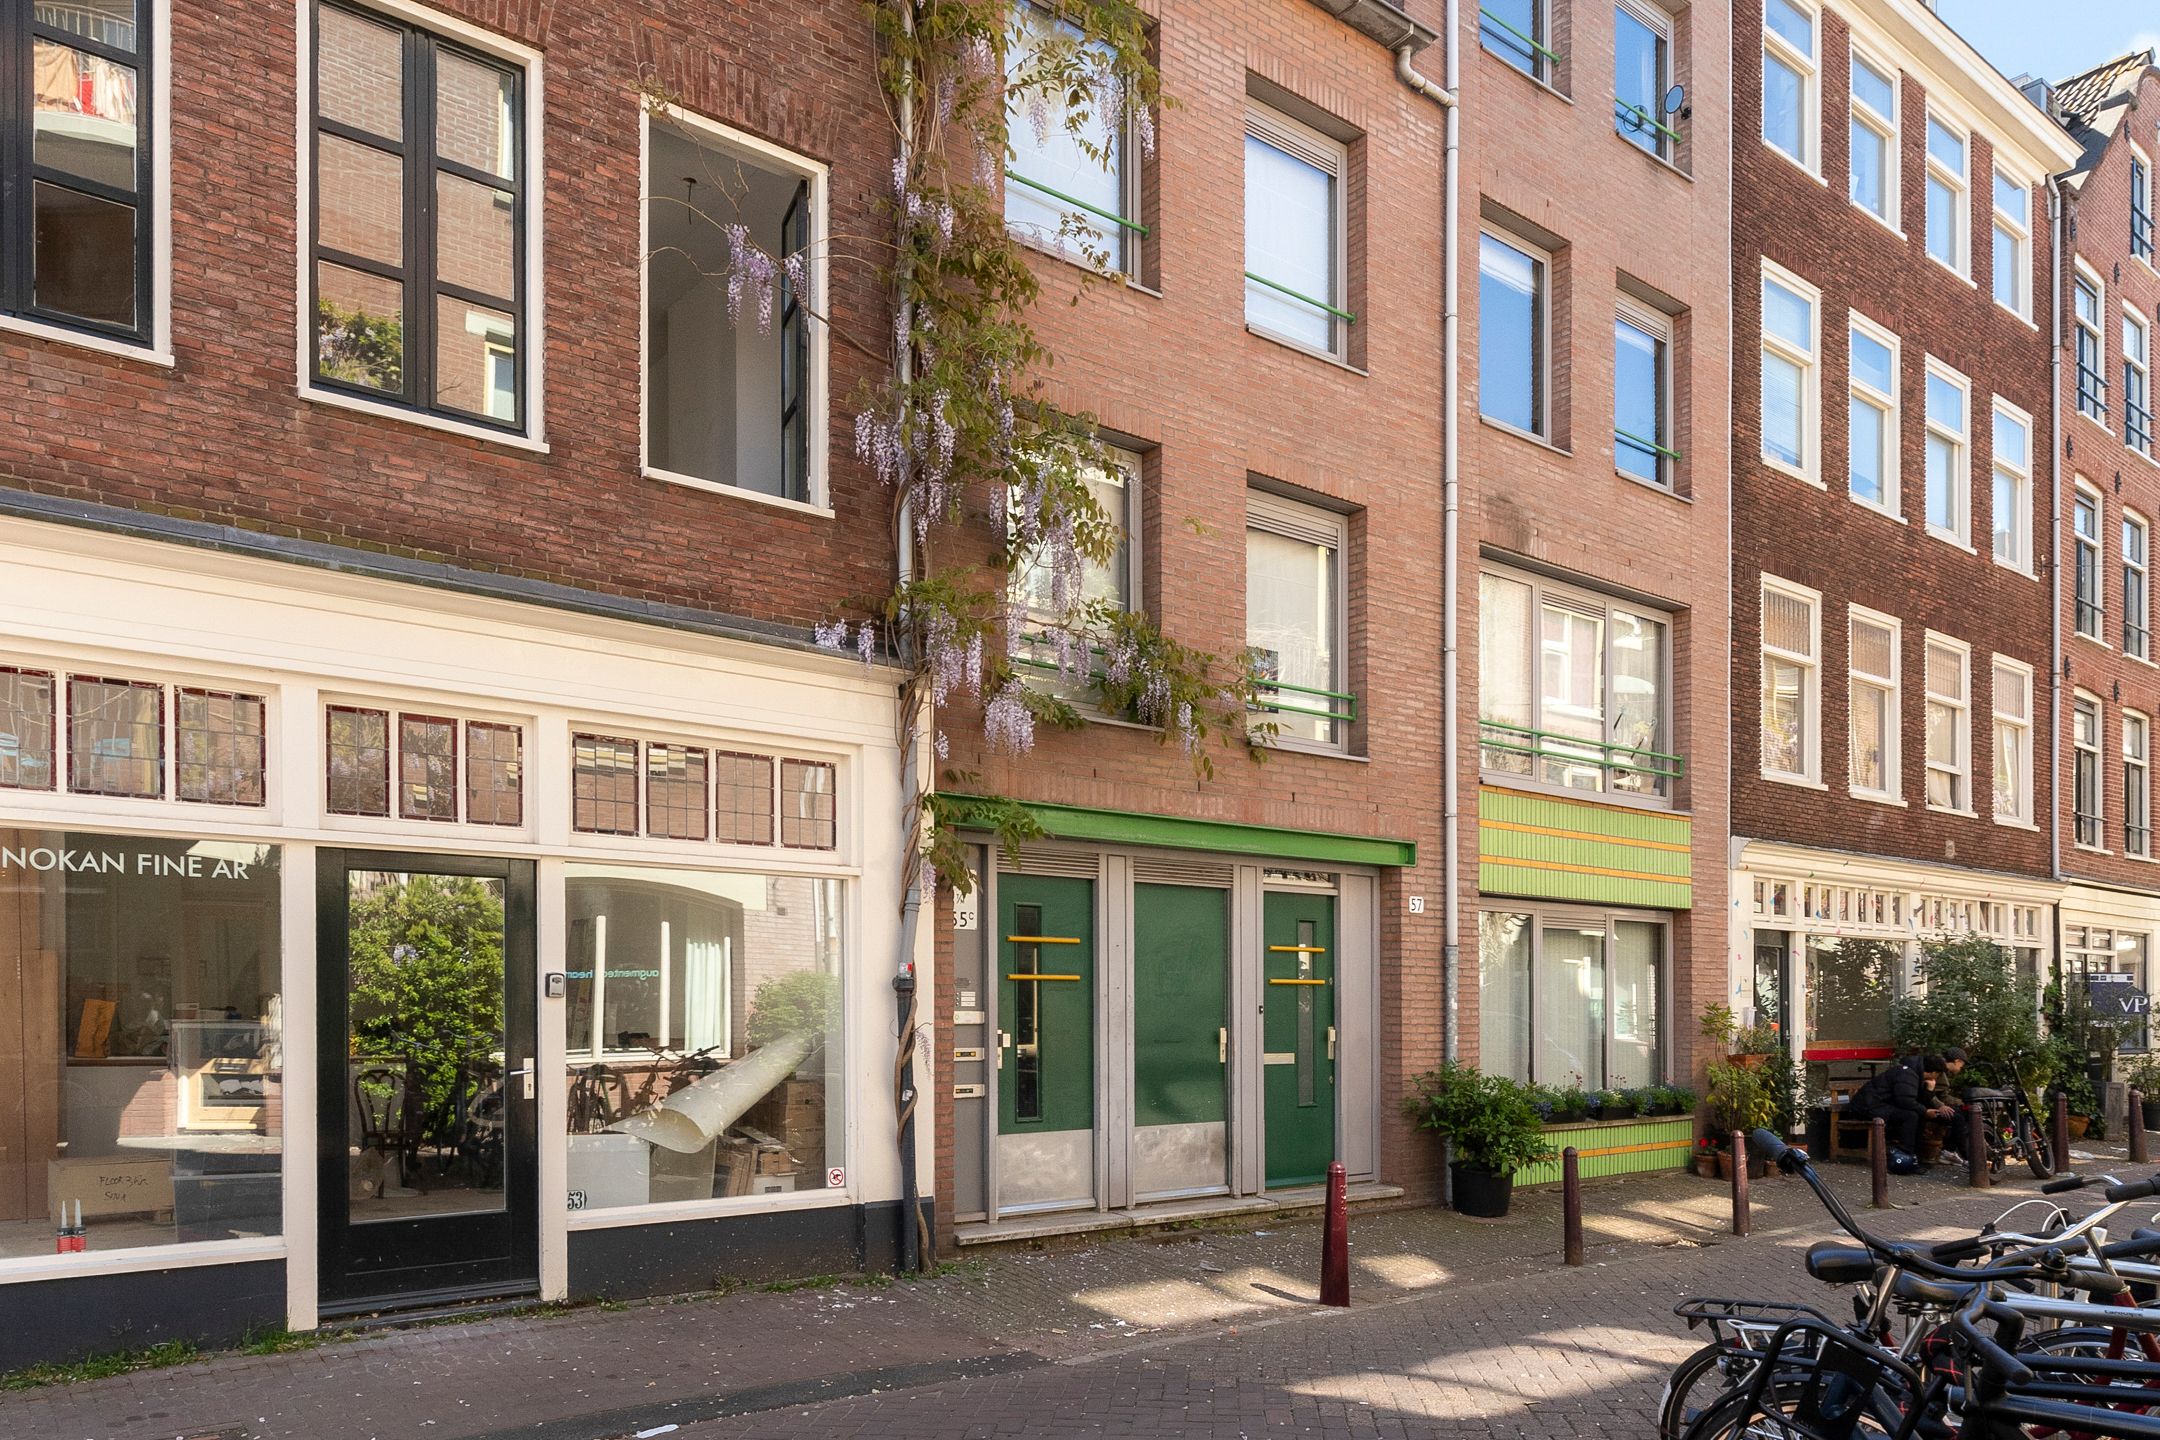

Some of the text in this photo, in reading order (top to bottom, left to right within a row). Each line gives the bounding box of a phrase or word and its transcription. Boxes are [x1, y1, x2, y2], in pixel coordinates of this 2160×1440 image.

[2, 846, 125, 875] NOKAN
[137, 853, 202, 878] FINE
[1411, 898, 1422, 911] 57
[567, 1191, 583, 1210] 53
